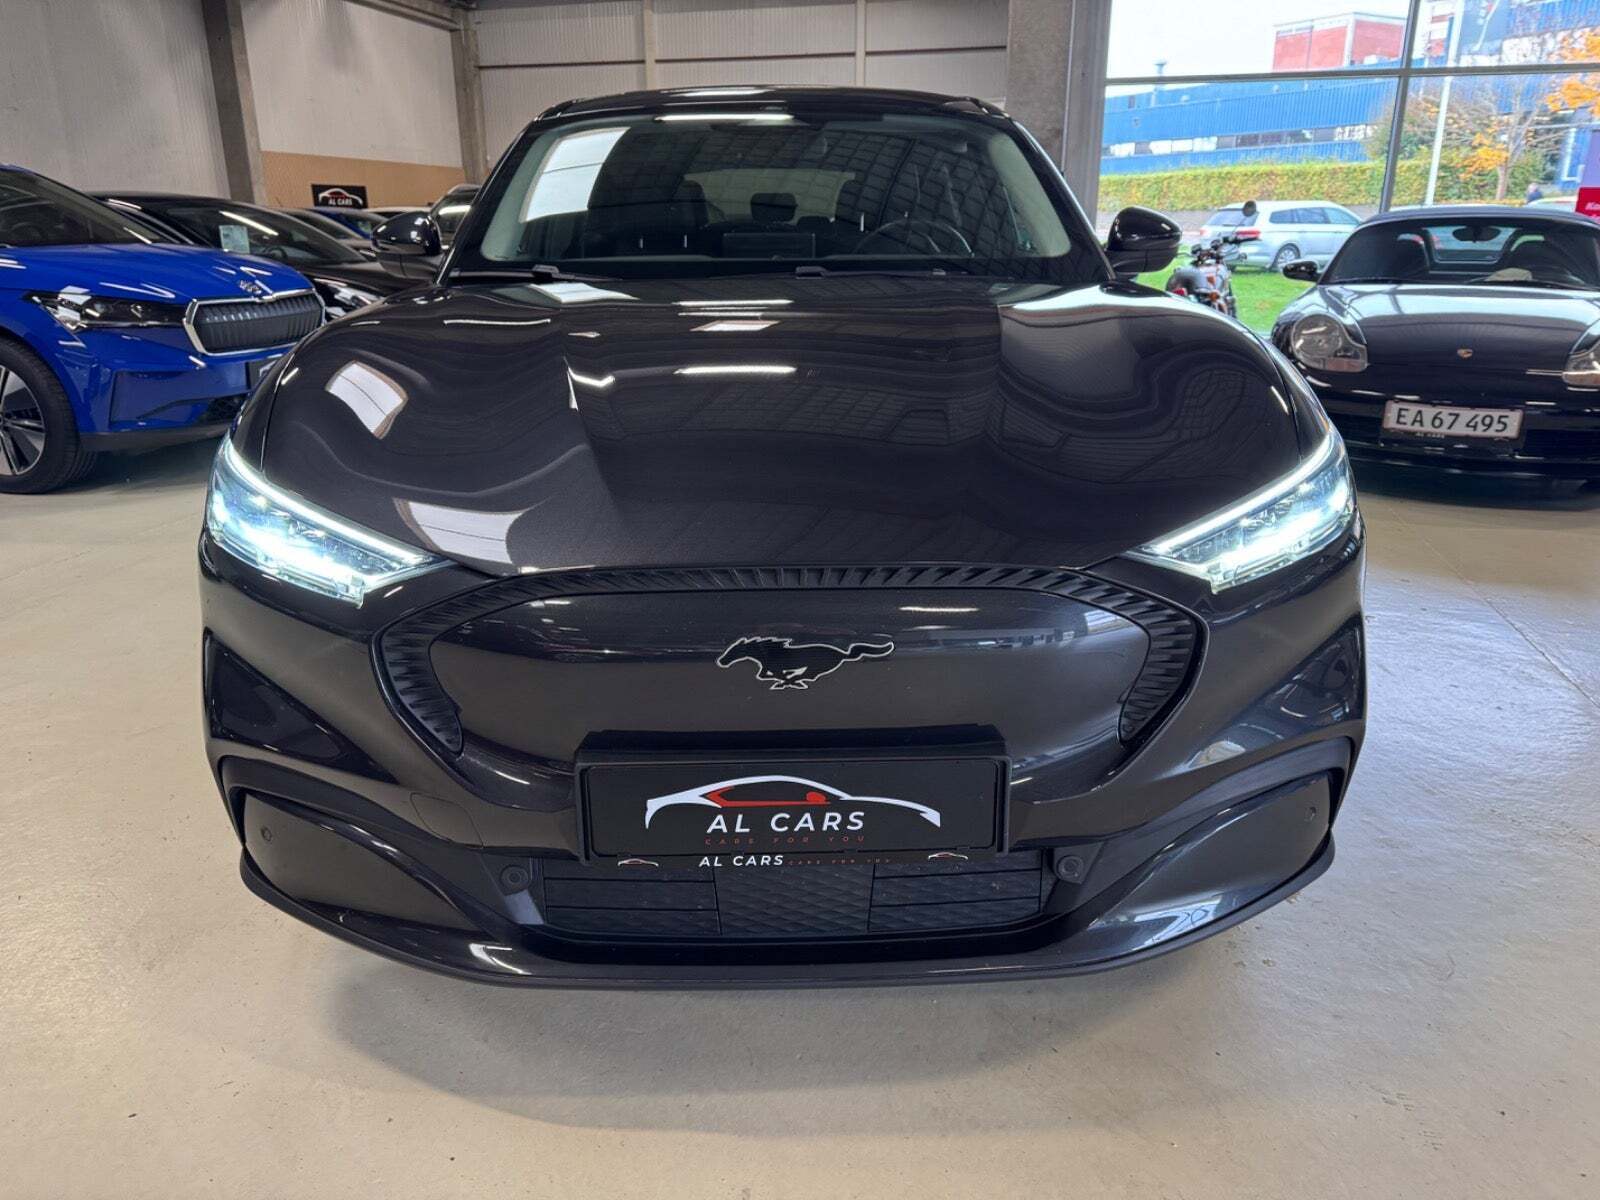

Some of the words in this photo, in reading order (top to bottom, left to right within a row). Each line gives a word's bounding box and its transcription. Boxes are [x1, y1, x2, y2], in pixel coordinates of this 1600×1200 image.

[1395, 408, 1425, 427] EA
[1431, 411, 1460, 430] 67
[1465, 414, 1510, 433] 495
[706, 813, 751, 834] AL
[770, 811, 865, 832] CARS
[772, 836, 809, 844] FOR
[828, 835, 865, 843] YOU
[699, 856, 723, 867] AL
[732, 855, 784, 867] CARS
